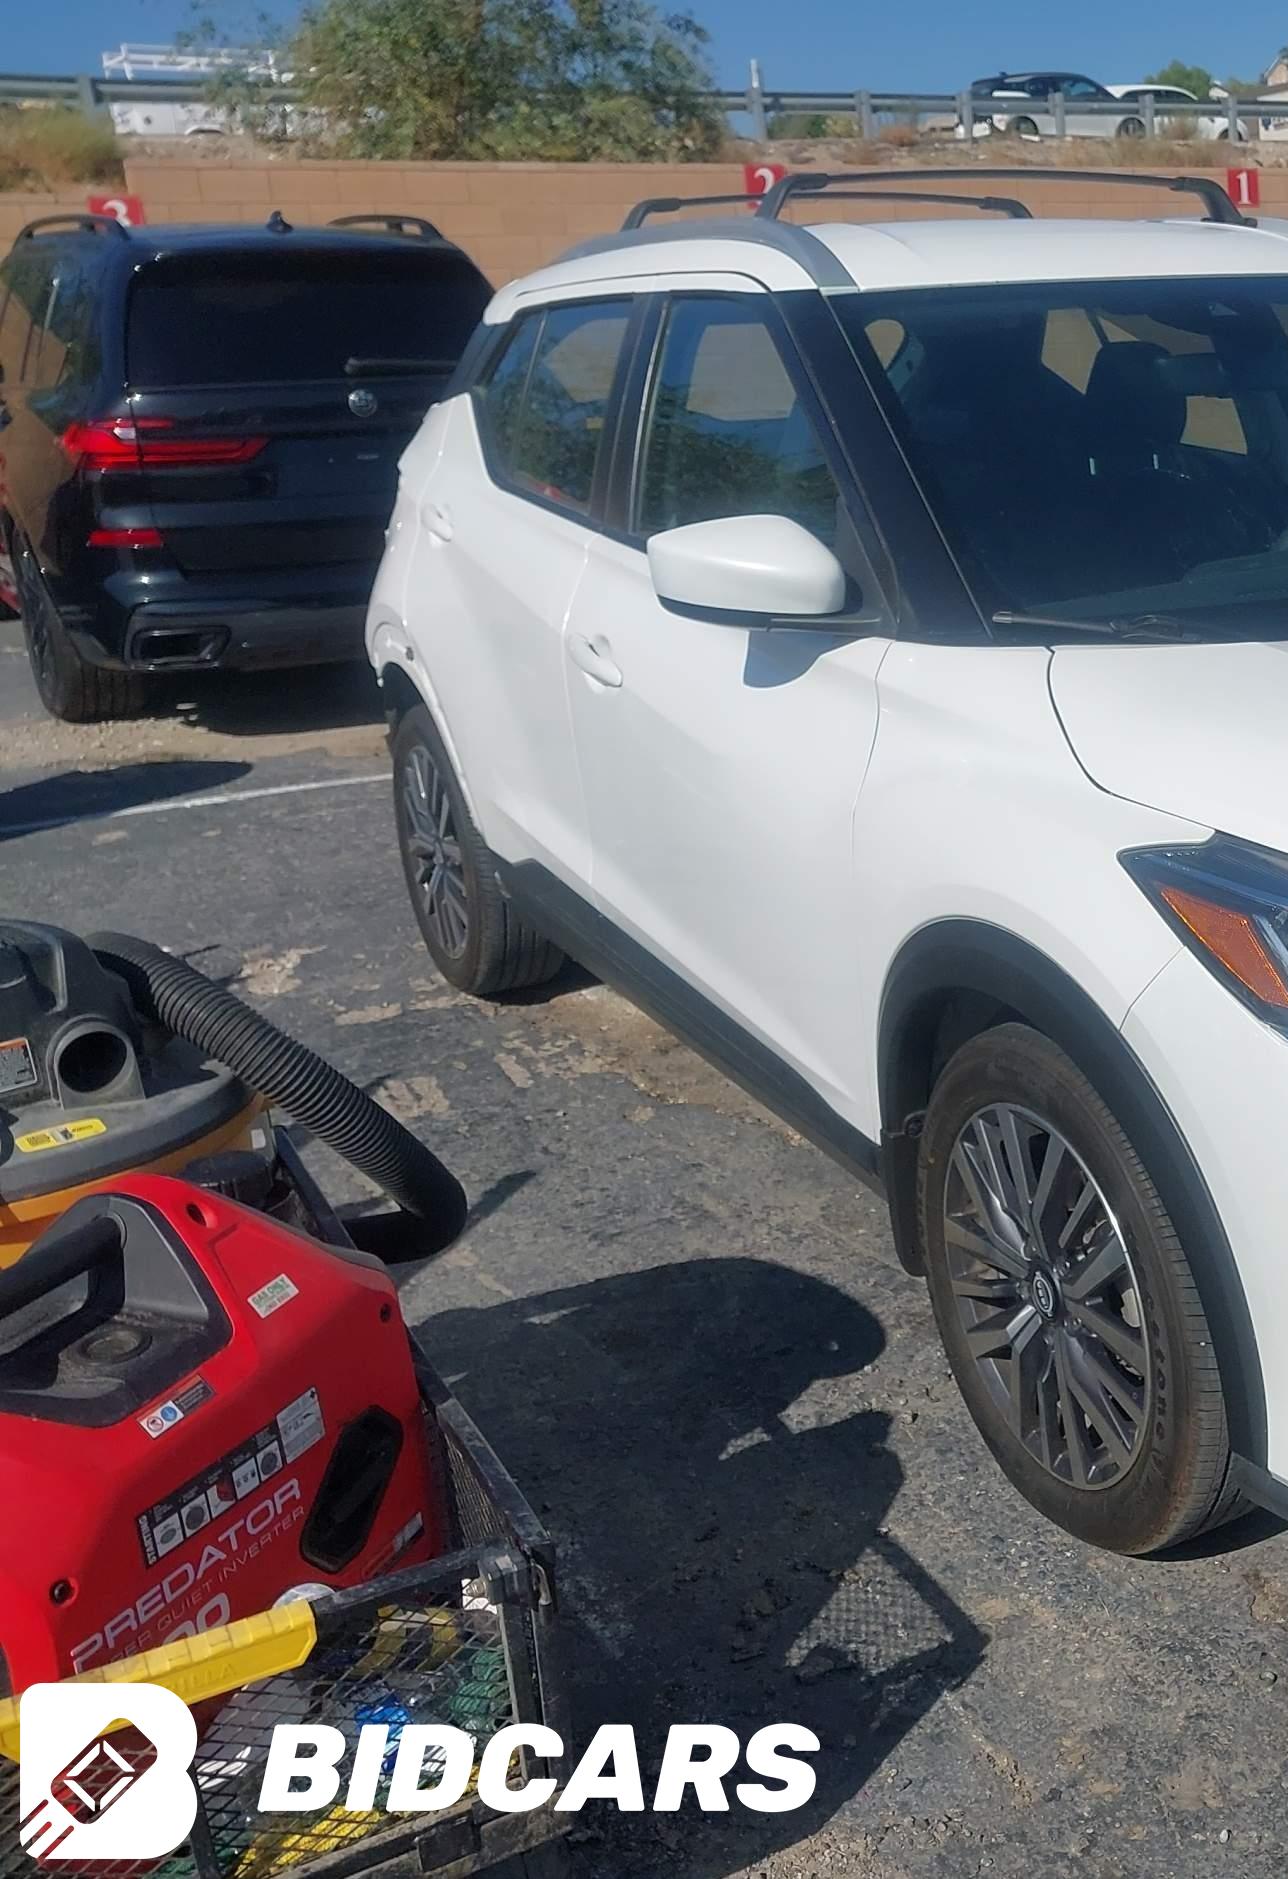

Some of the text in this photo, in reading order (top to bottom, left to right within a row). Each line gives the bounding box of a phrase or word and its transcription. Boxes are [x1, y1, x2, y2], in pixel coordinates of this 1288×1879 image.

[753, 167, 774, 206] 2
[1235, 170, 1252, 205] 1
[70, 1477, 302, 1676] PREDATOR
[157, 1580, 213, 1632] QUIET
[218, 1505, 305, 1584] INVERTER
